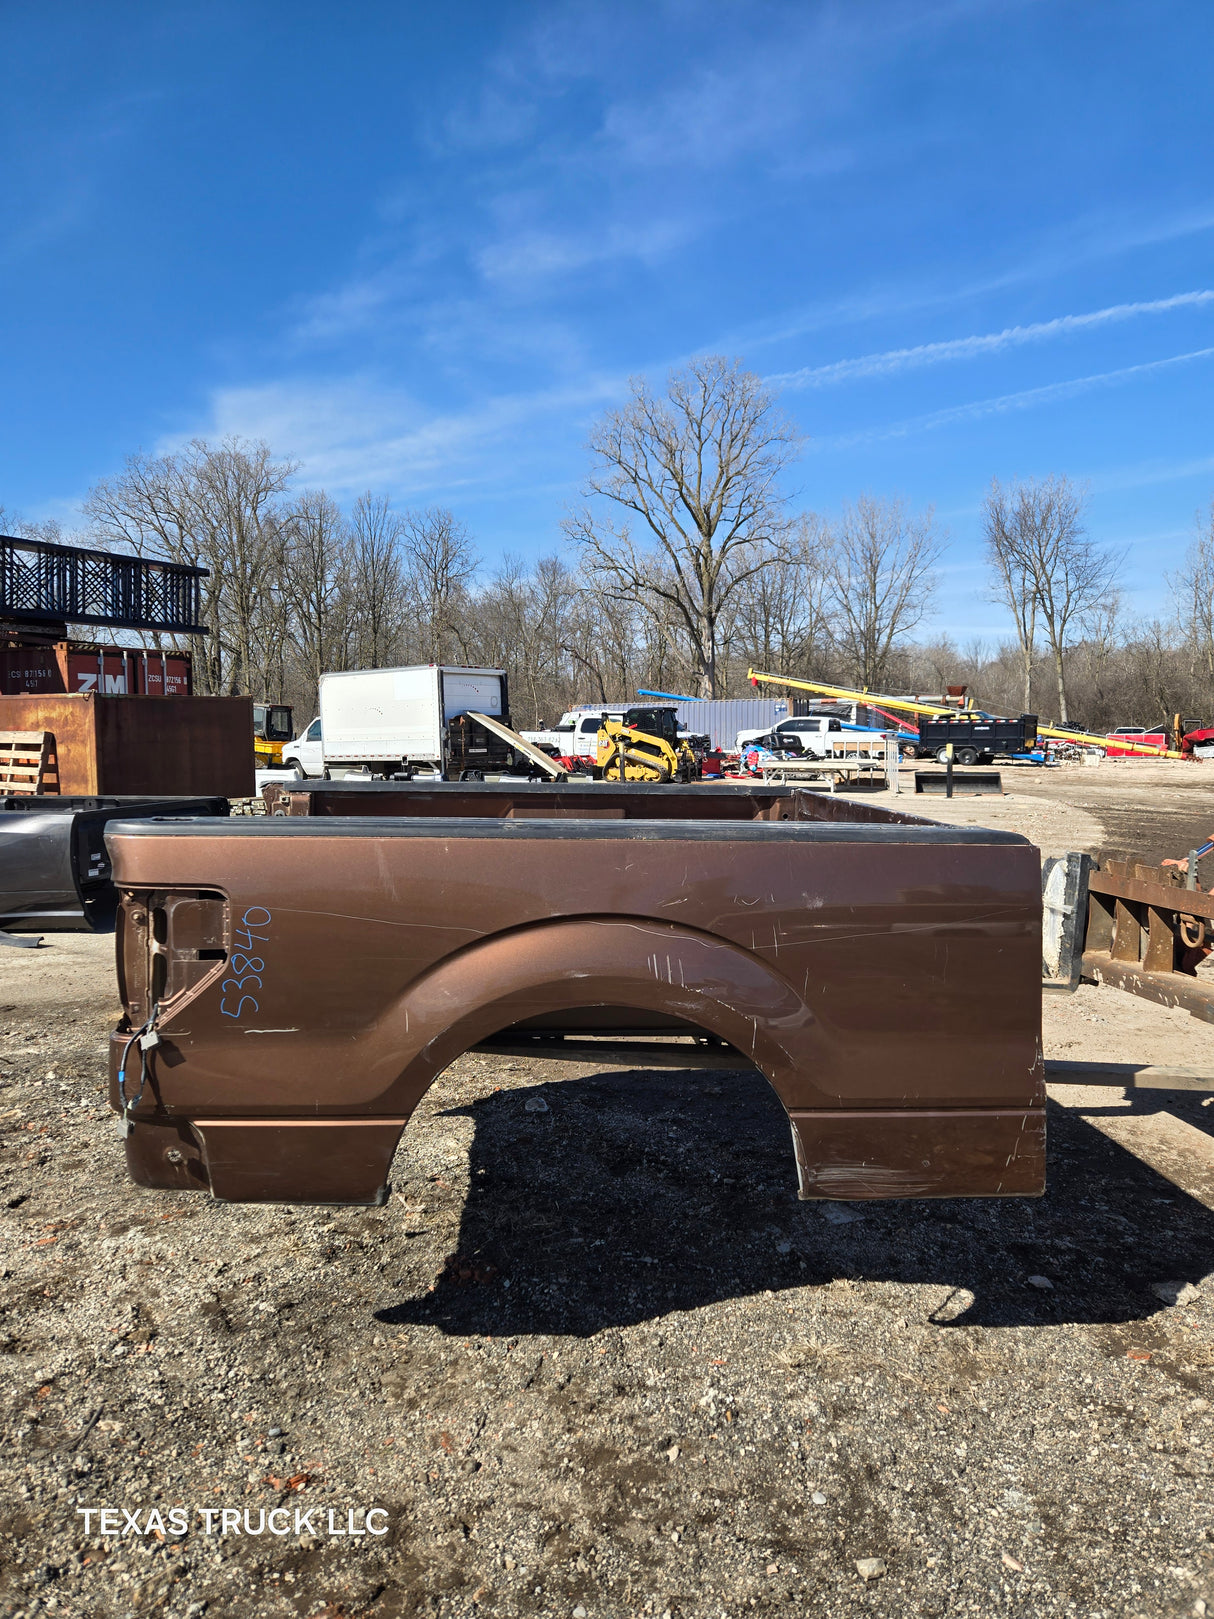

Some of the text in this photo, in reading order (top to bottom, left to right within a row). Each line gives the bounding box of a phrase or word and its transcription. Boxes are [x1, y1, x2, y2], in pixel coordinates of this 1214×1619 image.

[77, 672, 125, 694] ZIM
[148, 674, 162, 683] ZCSU
[220, 906, 272, 1018] 53840
